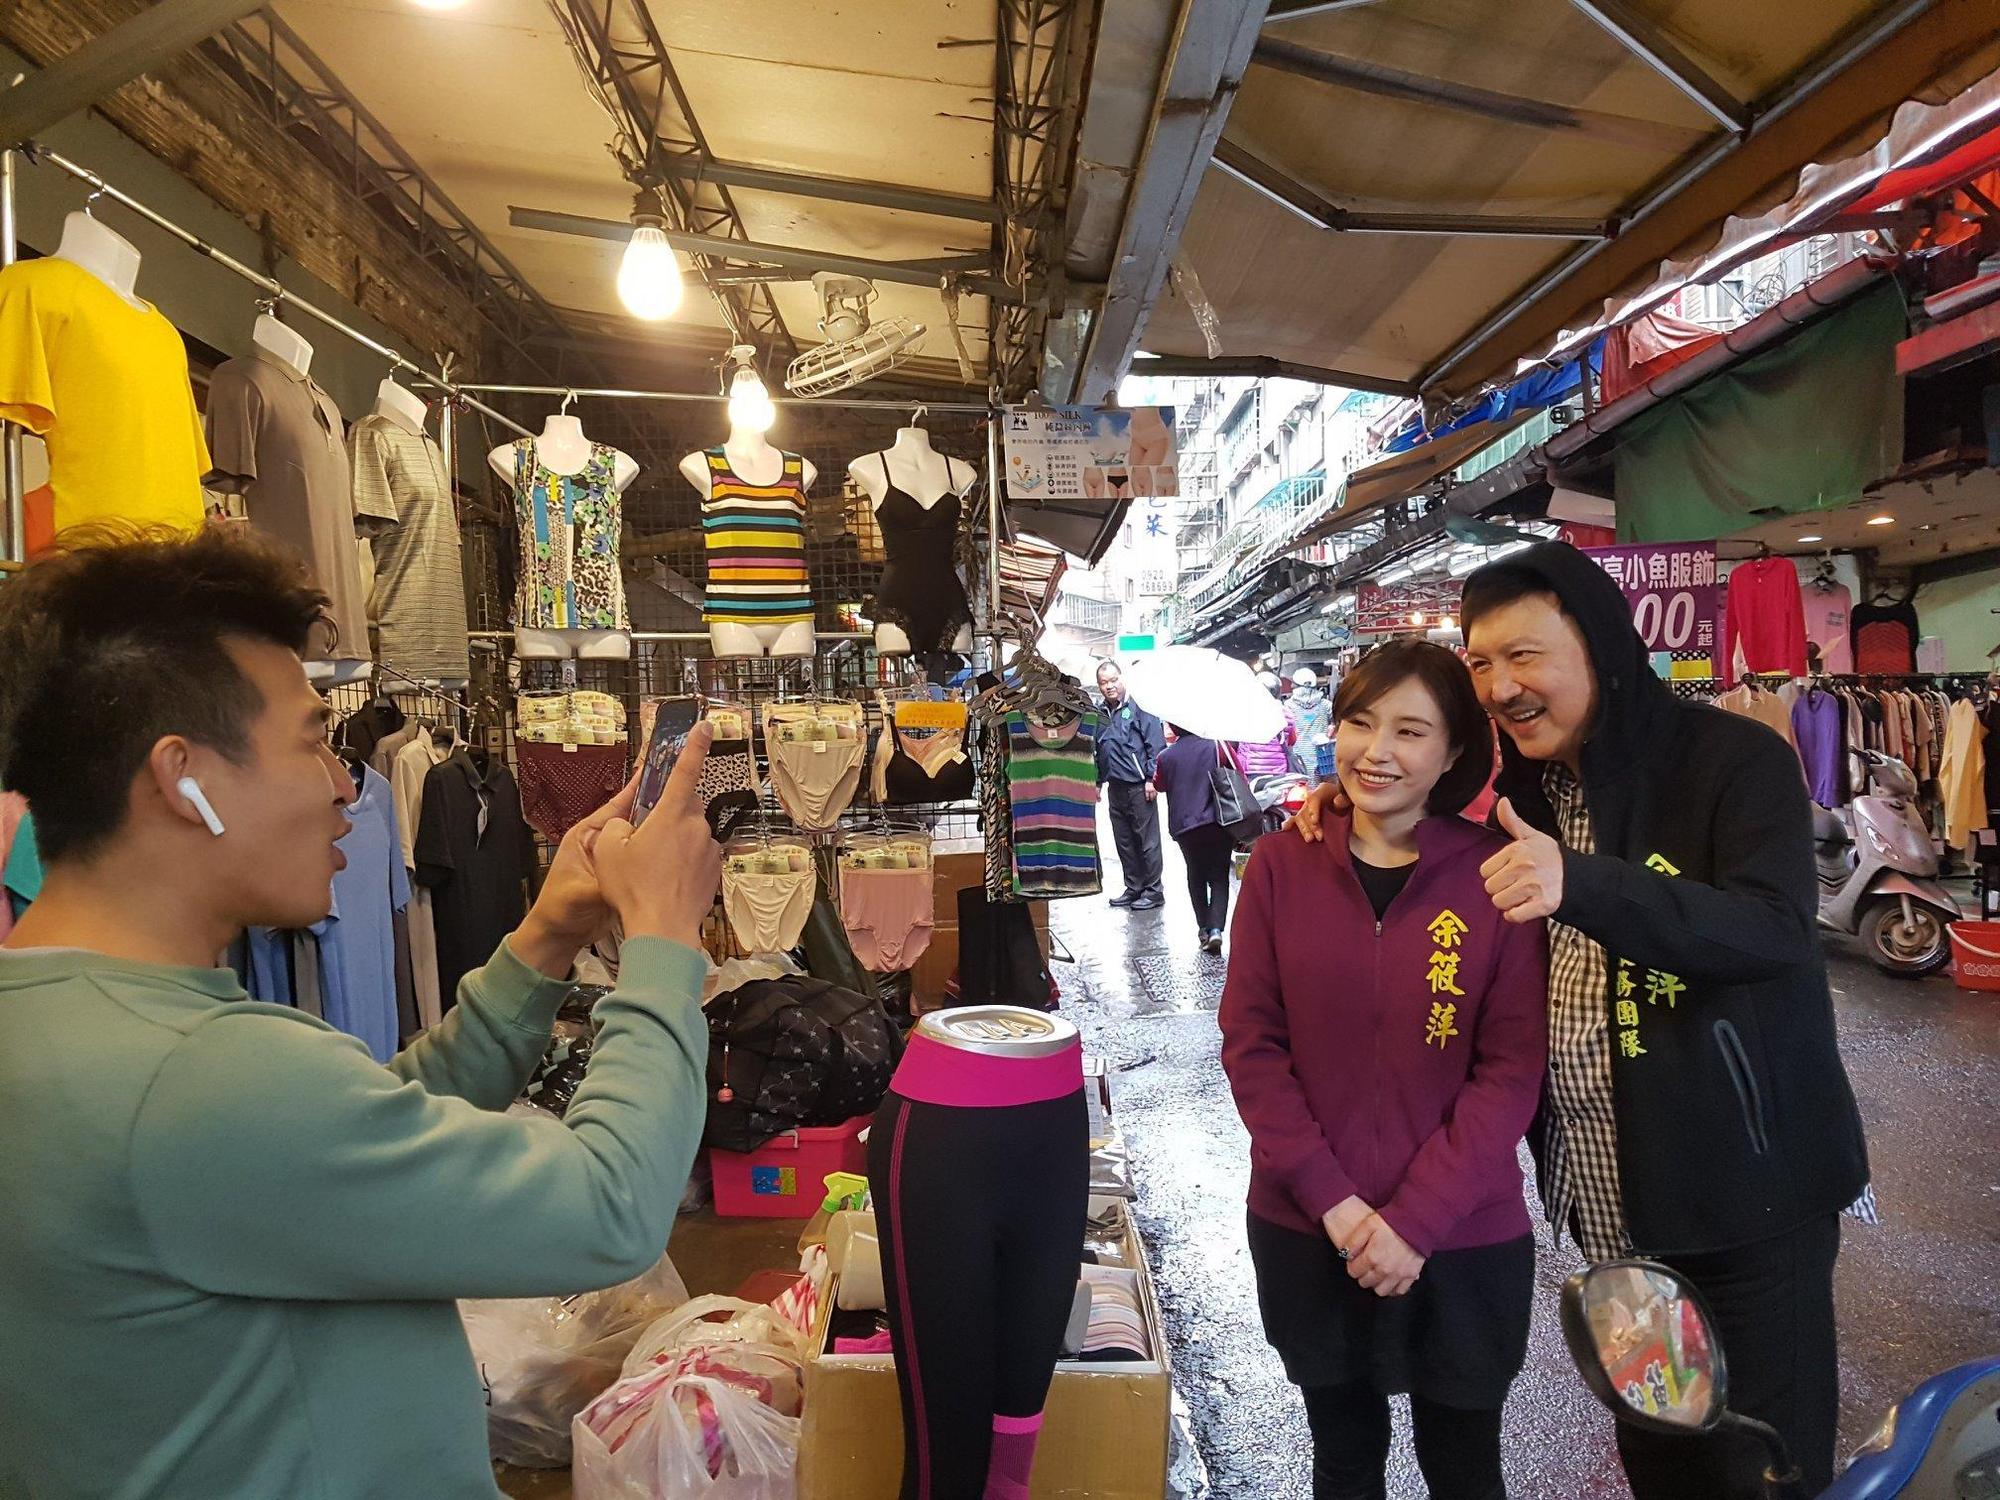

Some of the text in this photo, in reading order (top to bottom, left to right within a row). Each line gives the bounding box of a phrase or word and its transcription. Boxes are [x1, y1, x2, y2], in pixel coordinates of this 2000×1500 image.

[1059, 410, 1082, 420] SILK
[1591, 550, 1715, 590] 亮小魚服飾
[1697, 620, 1713, 646] 元起
[1616, 957, 1648, 1058] 務團隊
